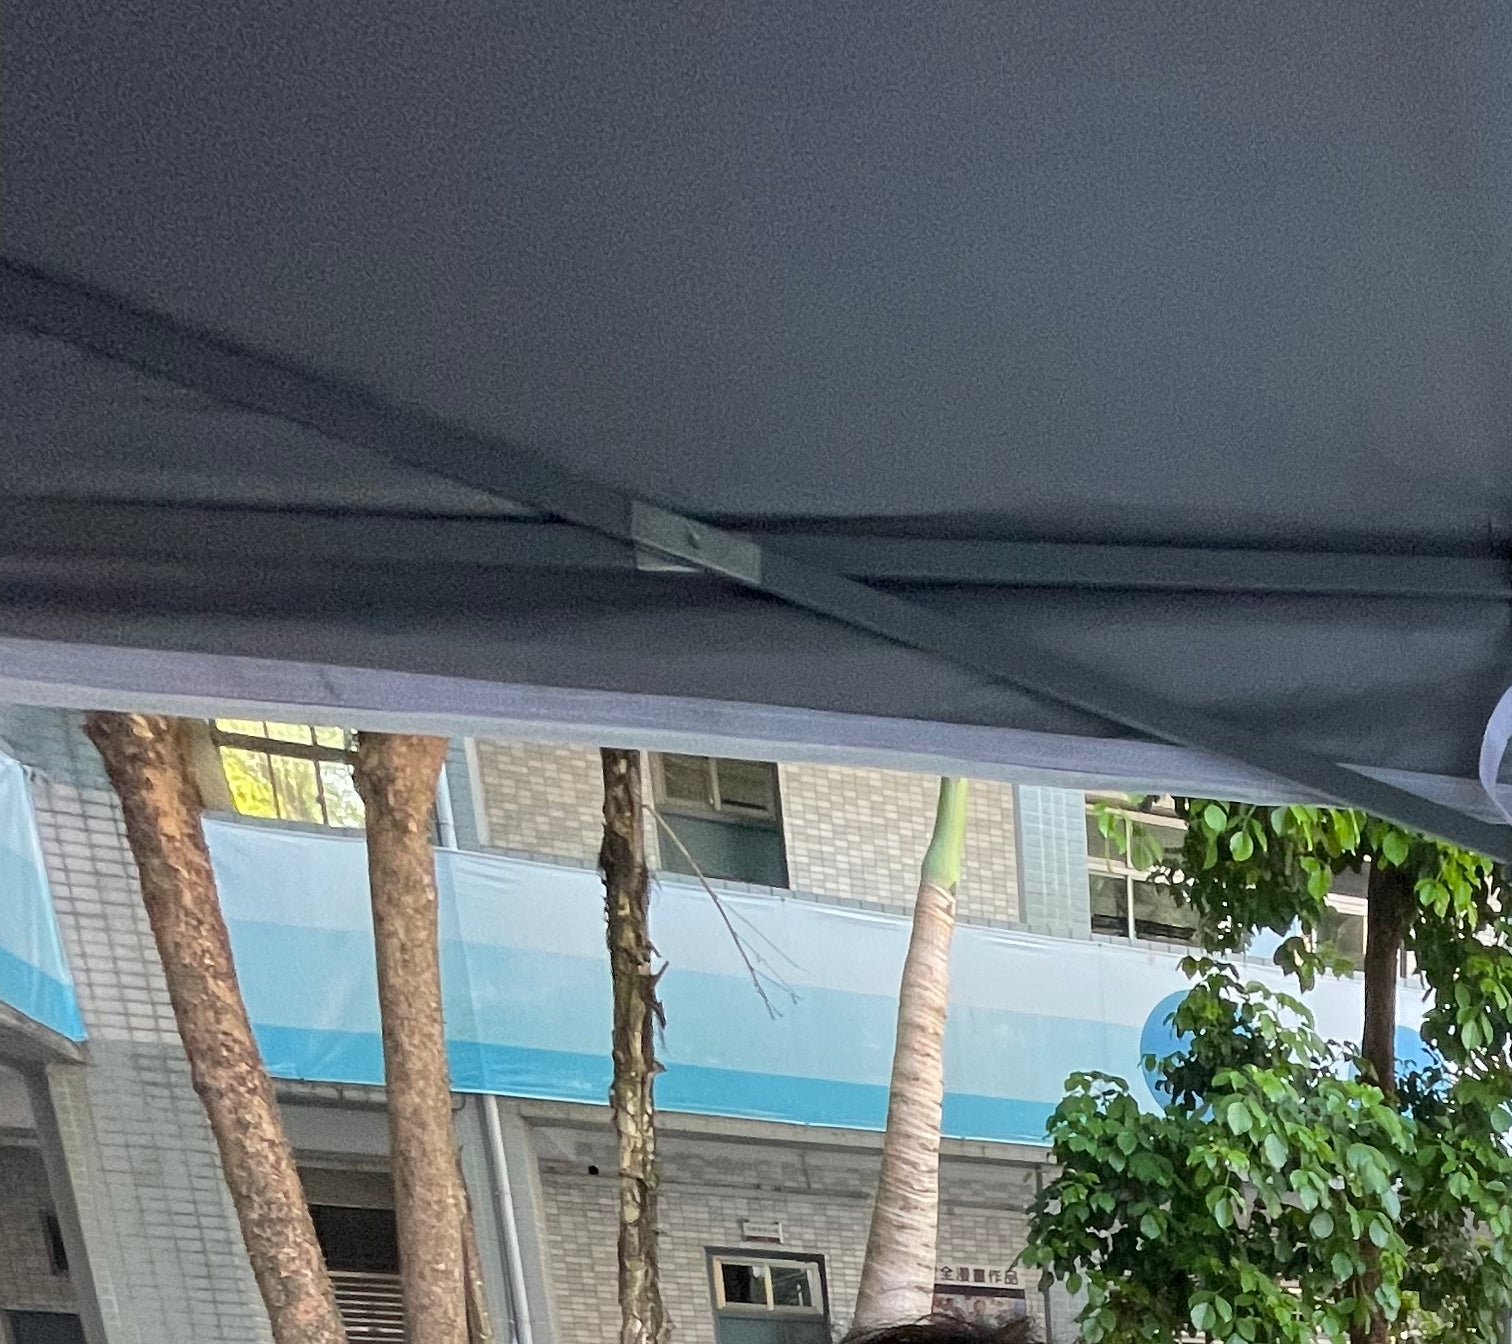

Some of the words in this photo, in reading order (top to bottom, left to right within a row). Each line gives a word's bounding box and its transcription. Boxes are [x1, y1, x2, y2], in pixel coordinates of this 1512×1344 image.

[934, 1264, 1019, 1286] 全漫畫作品
